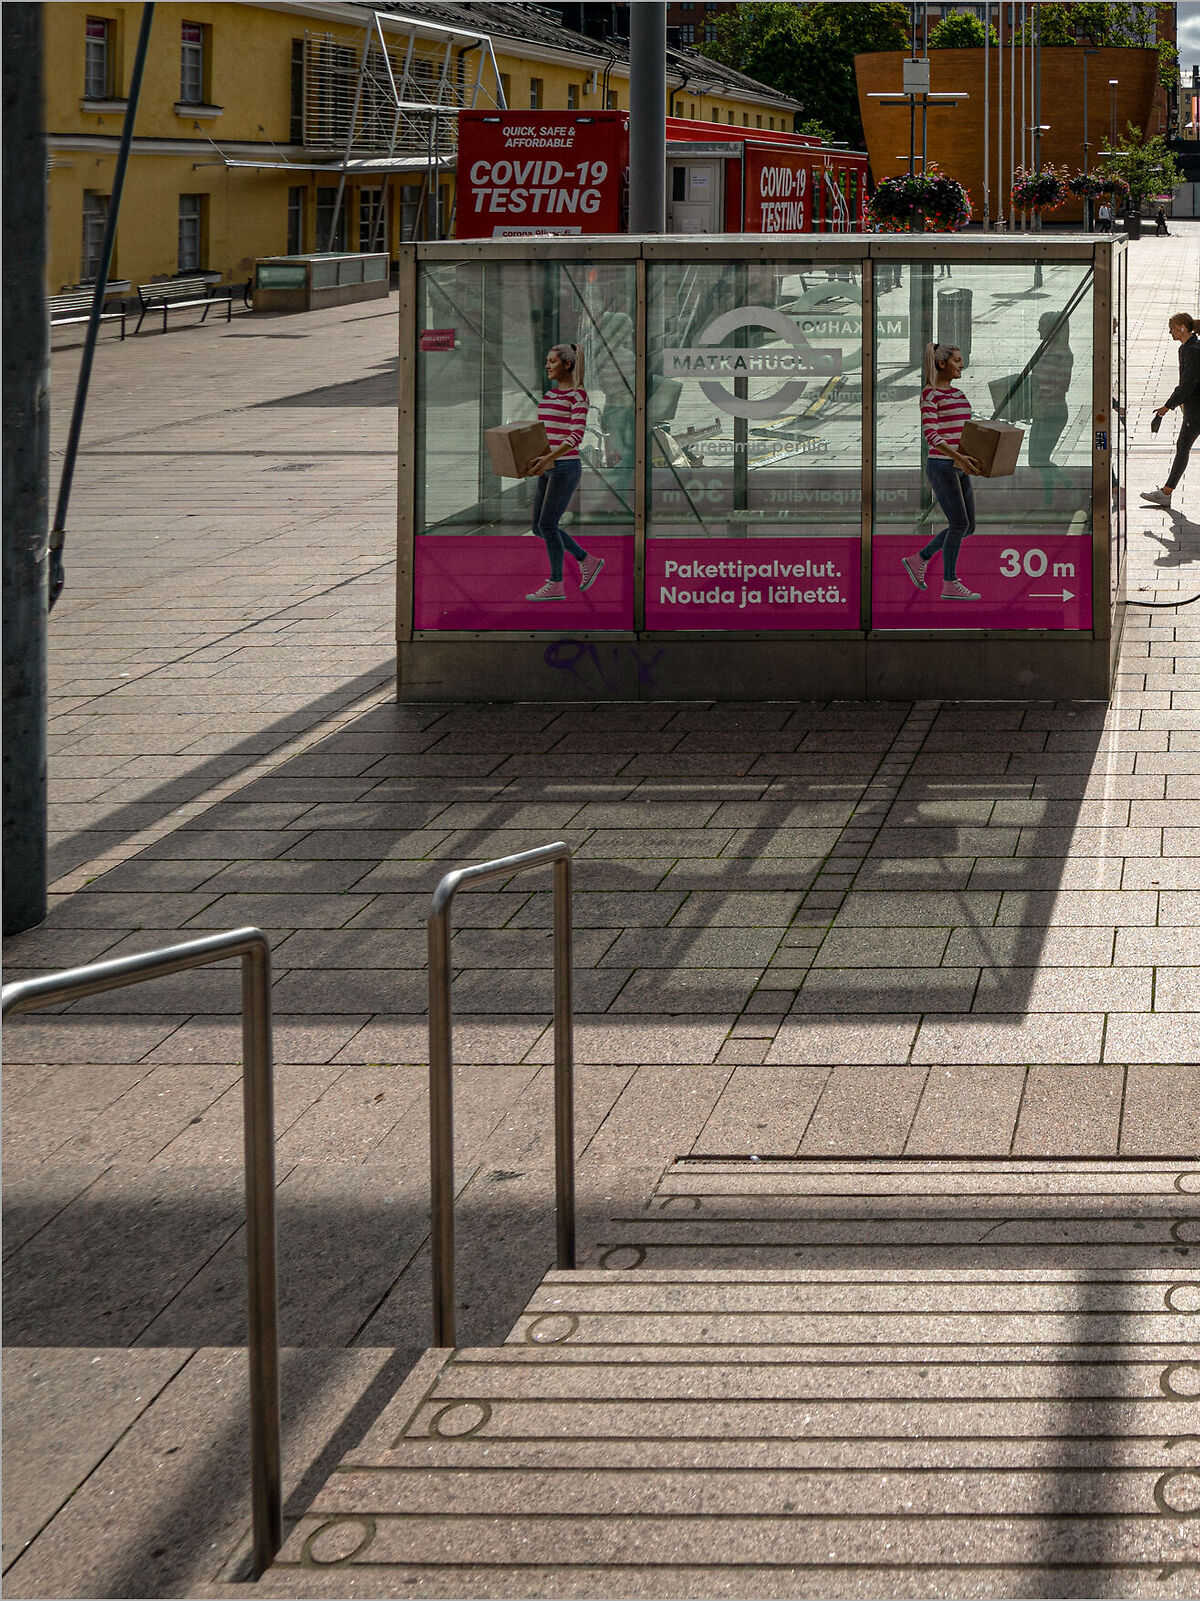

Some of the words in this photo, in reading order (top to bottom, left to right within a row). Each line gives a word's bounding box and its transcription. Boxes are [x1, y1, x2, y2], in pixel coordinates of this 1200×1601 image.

[502, 126, 537, 138] QUICK,
[539, 126, 566, 136] SAFE
[567, 126, 577, 136] &
[504, 138, 574, 148] AFFORDABLE
[470, 160, 608, 186] COVID-19
[760, 166, 806, 198] COVID-19
[471, 188, 602, 214] TESTING
[760, 201, 804, 233] TESTING
[672, 355, 834, 371] MATKAHUOLO
[665, 559, 842, 581] Pakettipalvelut.
[999, 548, 1048, 578] 30
[1053, 562, 1075, 577] m
[660, 586, 735, 604] Nouda
[739, 586, 762, 609] ja
[768, 585, 847, 604] lähetä.
